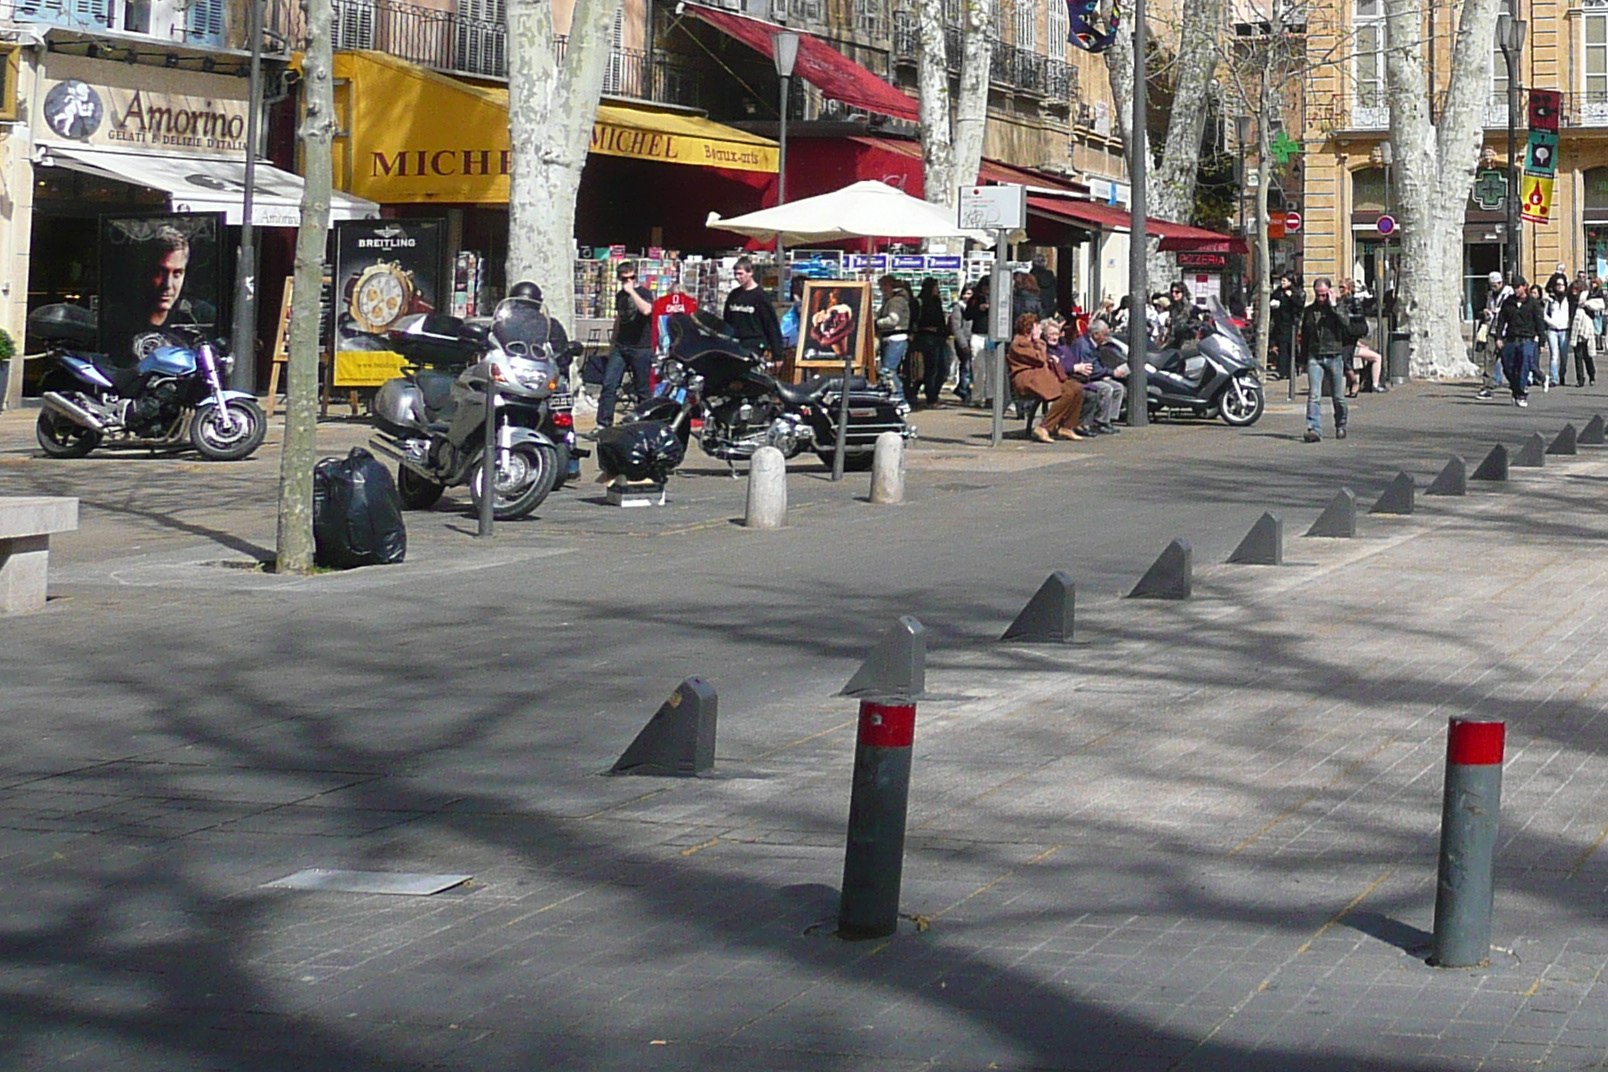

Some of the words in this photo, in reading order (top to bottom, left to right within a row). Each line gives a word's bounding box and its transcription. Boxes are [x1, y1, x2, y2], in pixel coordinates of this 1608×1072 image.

[120, 88, 244, 140] Amorino
[108, 129, 145, 143] GELATI
[163, 135, 202, 147] DELIZIE
[358, 238, 416, 248] BREITLING
